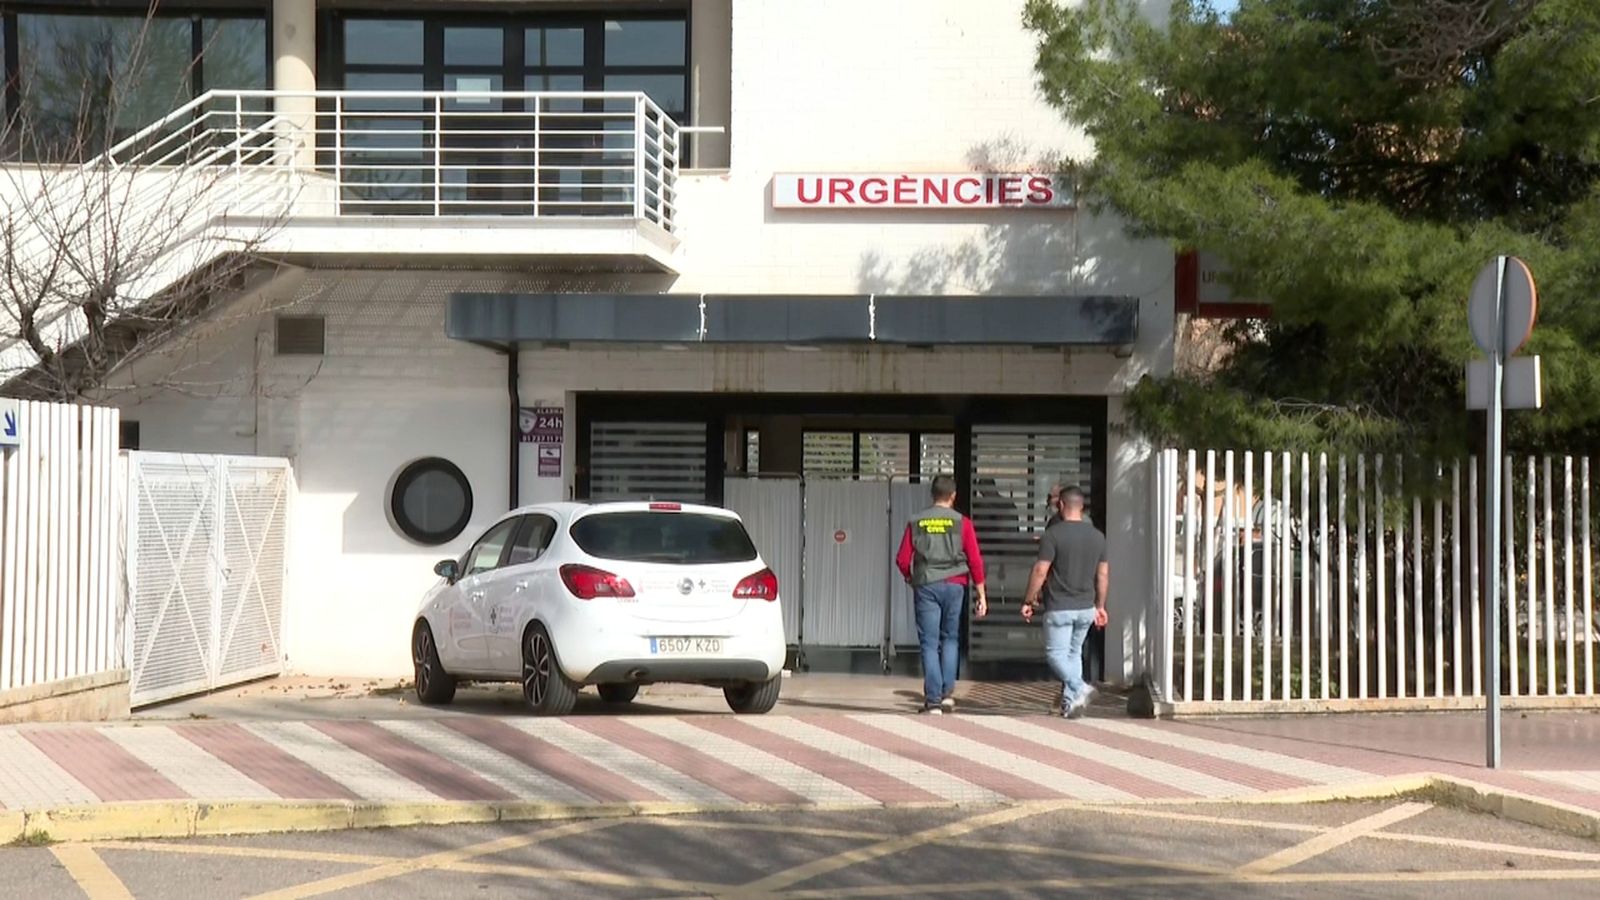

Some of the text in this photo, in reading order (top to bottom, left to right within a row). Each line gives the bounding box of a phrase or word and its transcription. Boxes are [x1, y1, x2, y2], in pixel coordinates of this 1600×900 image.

[797, 175, 1053, 204] URGÈNCIES
[539, 417, 562, 428] 24h
[919, 519, 953, 527] GUARDIA
[659, 639, 691, 652] 6507
